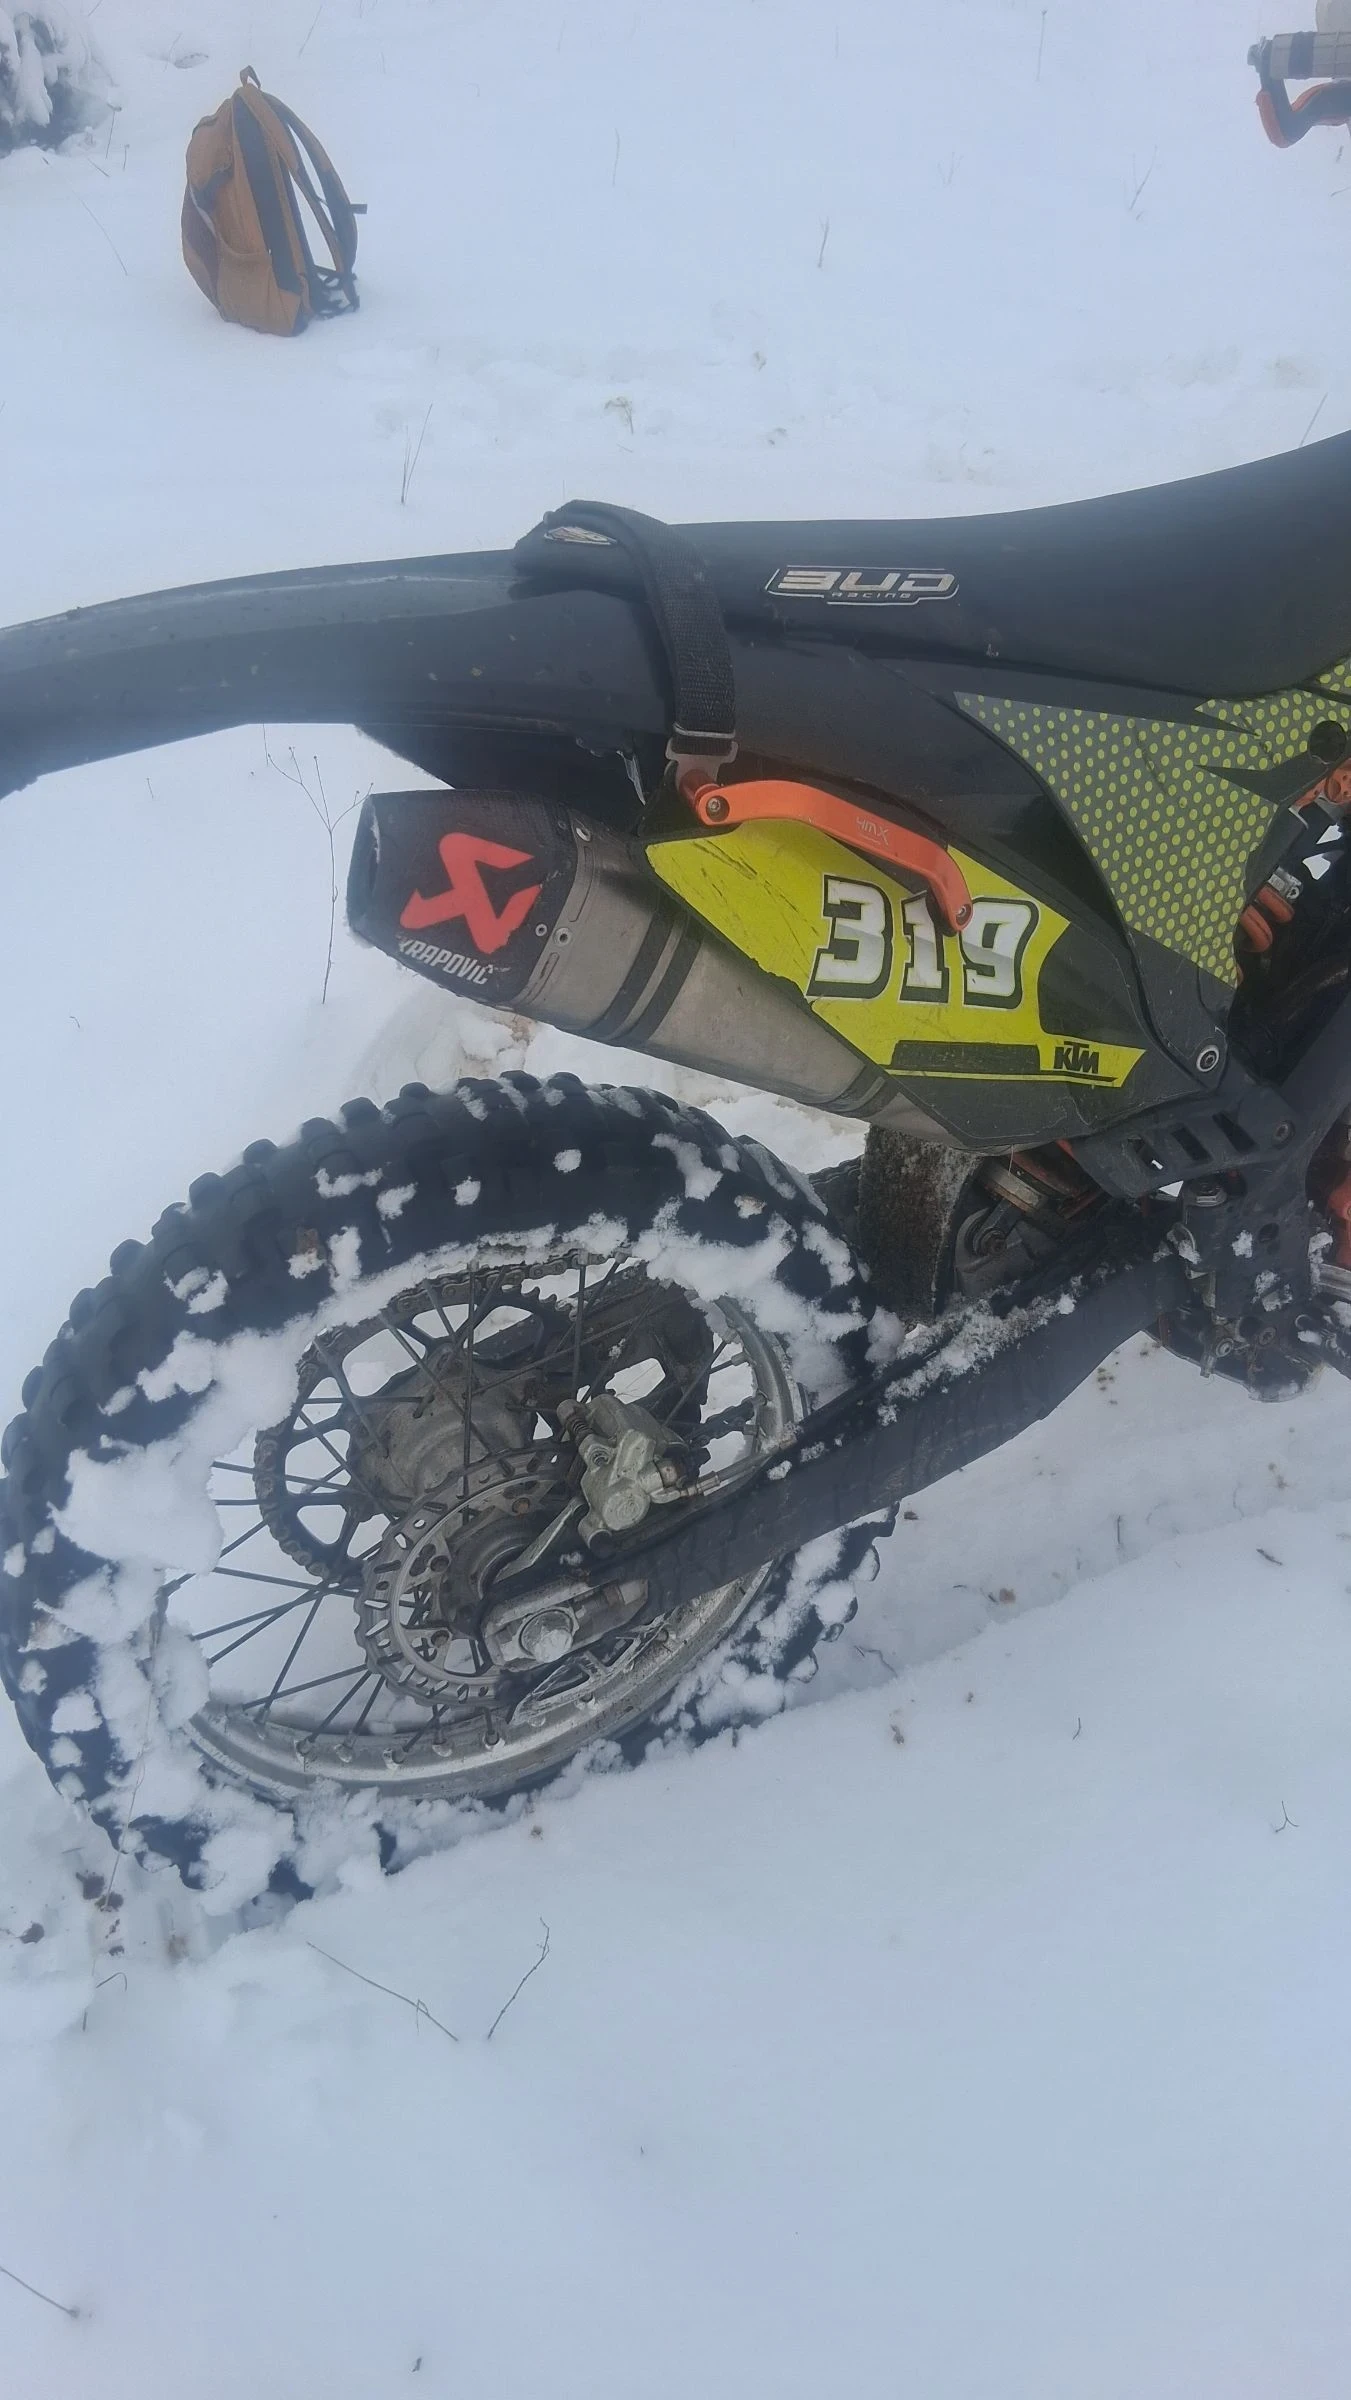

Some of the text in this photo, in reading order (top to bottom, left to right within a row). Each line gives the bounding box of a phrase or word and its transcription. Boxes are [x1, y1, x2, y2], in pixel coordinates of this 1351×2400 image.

[777, 570, 955, 592] BUD
[806, 874, 1040, 1010] 319
[1053, 1040, 1100, 1074] KTM
